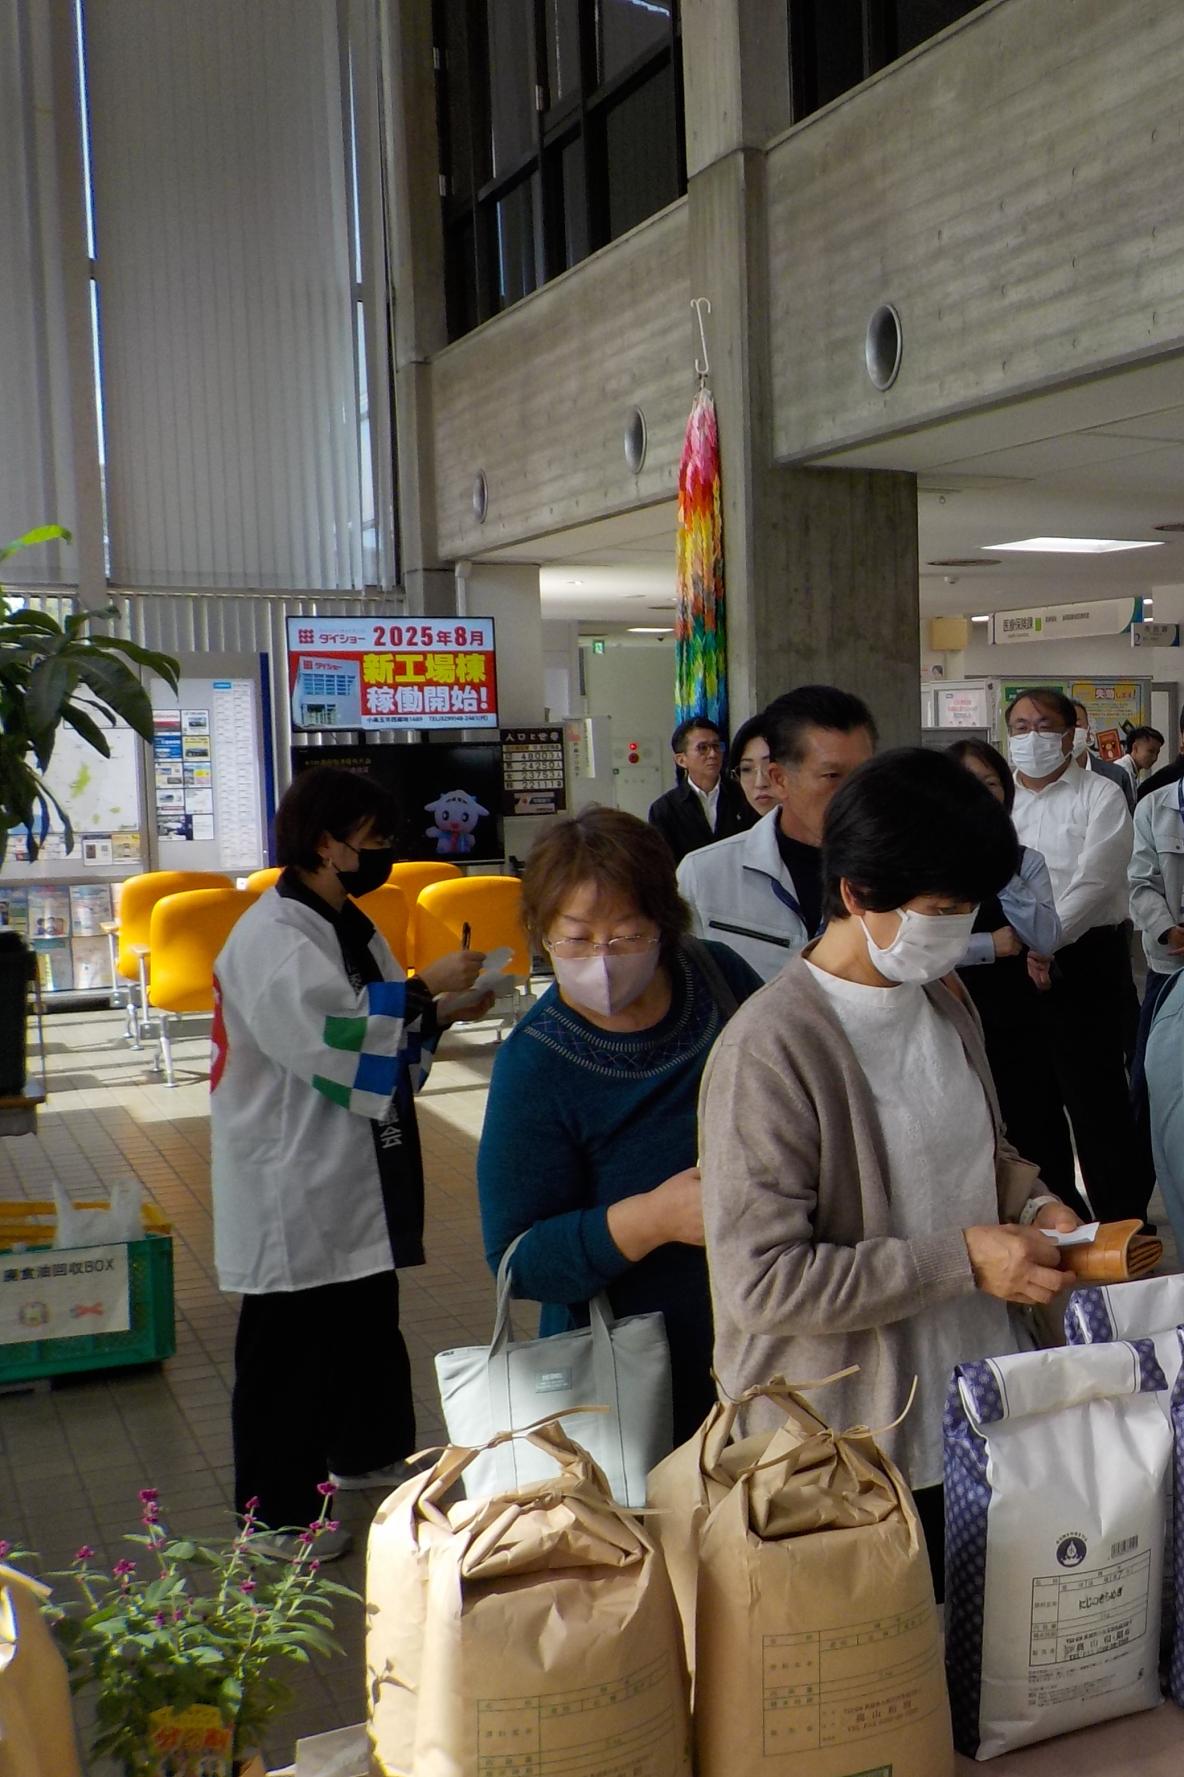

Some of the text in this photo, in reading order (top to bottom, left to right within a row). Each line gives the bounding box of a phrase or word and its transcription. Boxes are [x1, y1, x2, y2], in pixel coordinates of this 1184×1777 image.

[319, 625, 485, 647] ダイショー 2025年8月
[362, 652, 487, 684] 新工場棟
[366, 685, 489, 714] 稼働開始!
